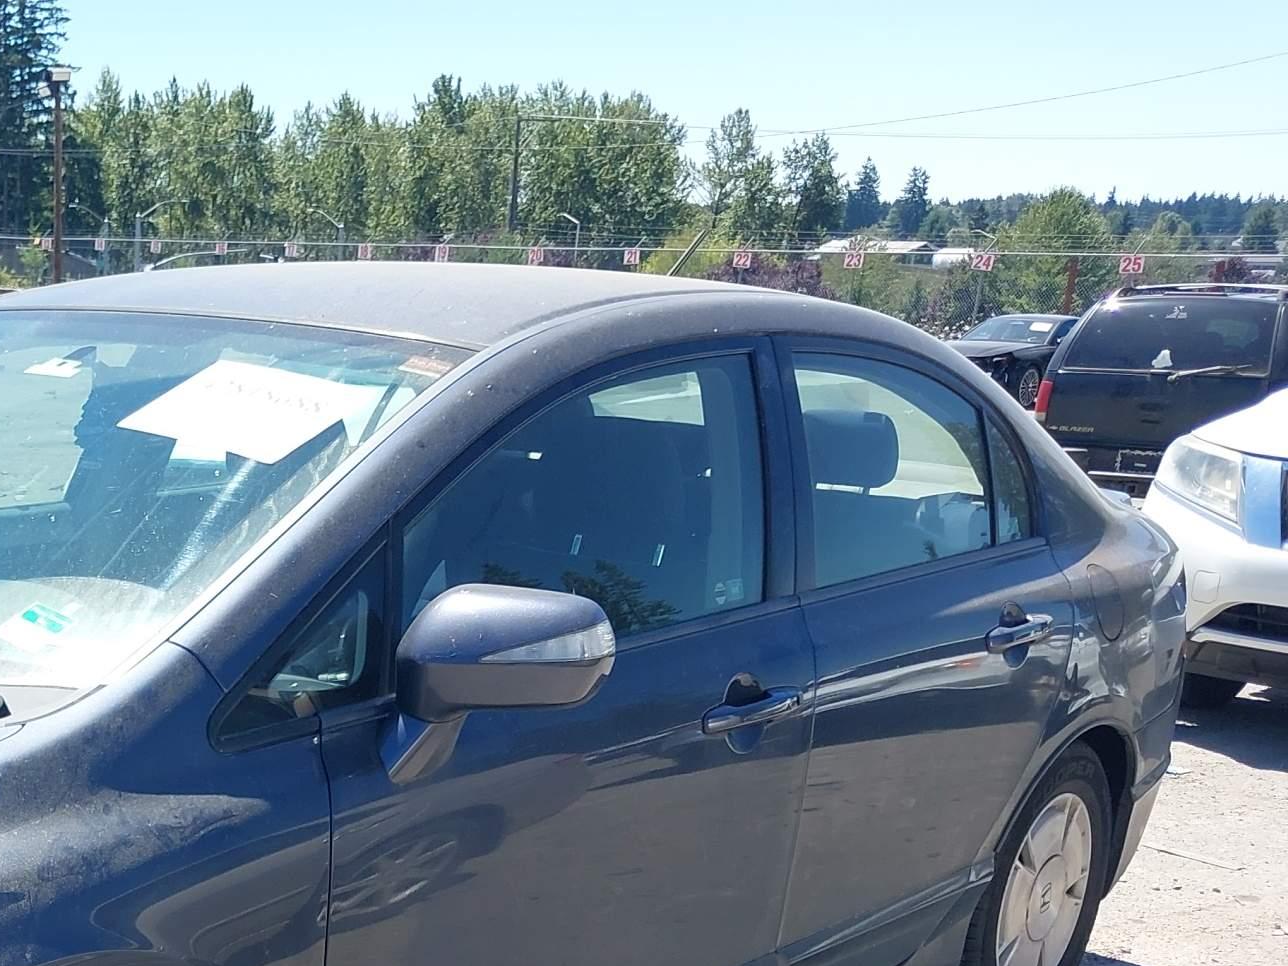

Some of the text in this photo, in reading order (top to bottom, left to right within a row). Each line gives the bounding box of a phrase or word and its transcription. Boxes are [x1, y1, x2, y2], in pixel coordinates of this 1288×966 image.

[437, 244, 448, 258] 19
[529, 248, 543, 262] 20
[626, 250, 638, 264] 21
[734, 253, 750, 267] 22
[845, 253, 862, 268] 23
[973, 254, 993, 270] 24
[1120, 256, 1142, 273] 25
[1058, 424, 1095, 433] BLAZER
